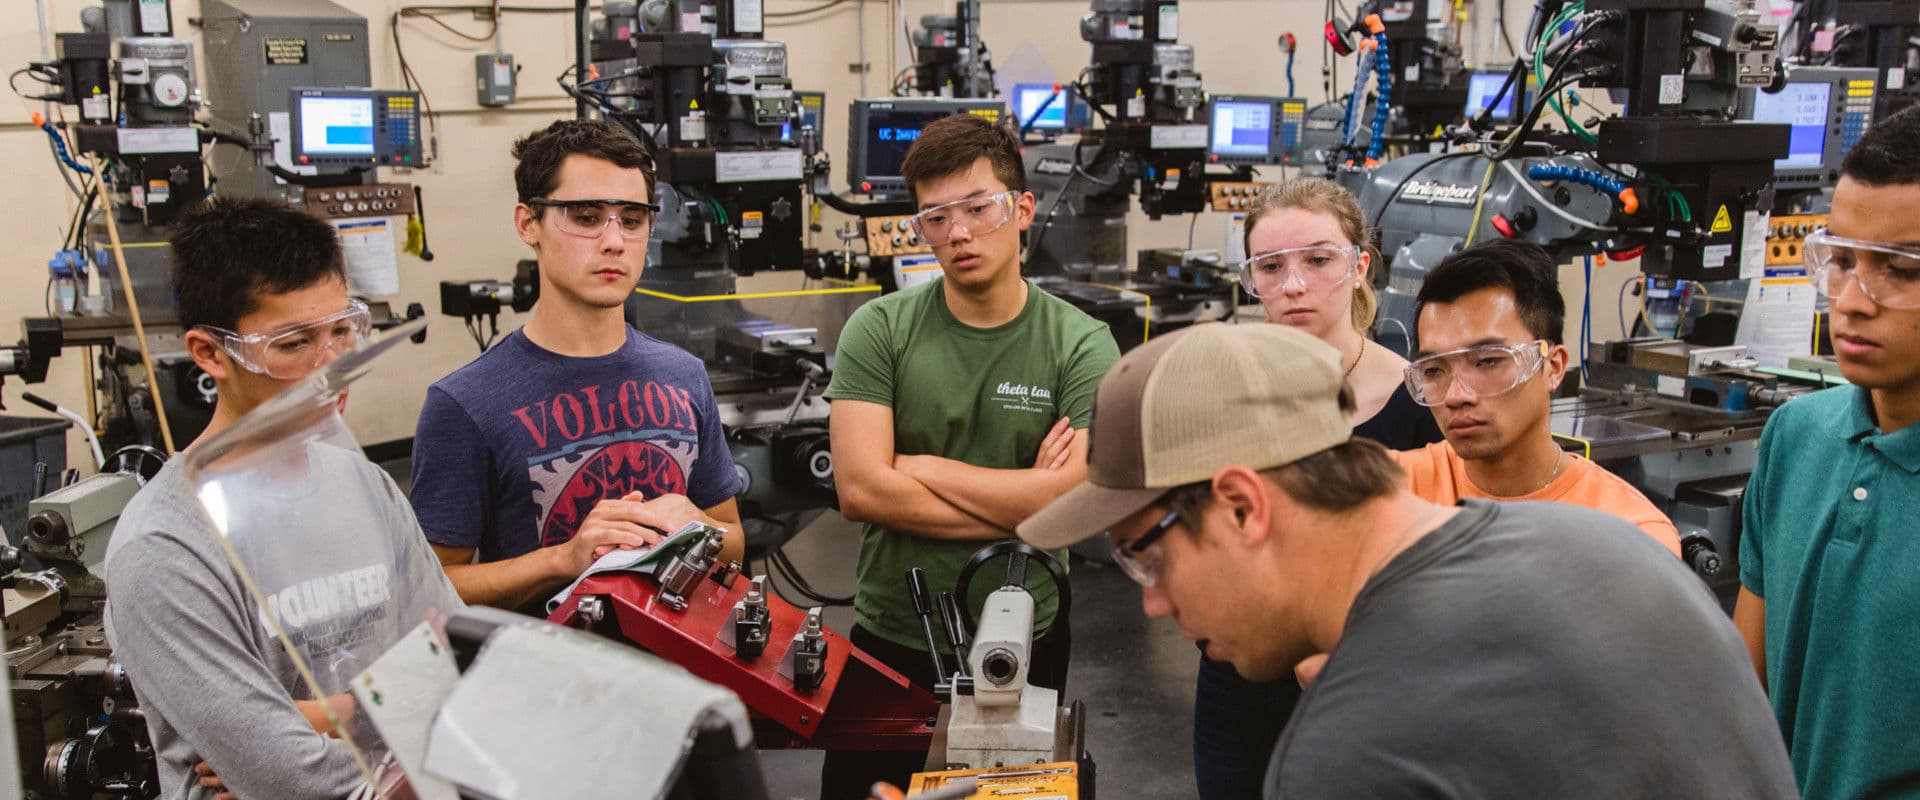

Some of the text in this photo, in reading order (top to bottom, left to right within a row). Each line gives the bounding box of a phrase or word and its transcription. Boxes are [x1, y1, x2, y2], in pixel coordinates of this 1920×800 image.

[878, 127, 891, 140] UC
[1402, 180, 1478, 204] Bridgeport
[997, 381, 1051, 399] theta tau
[510, 379, 696, 449] VOLCOM
